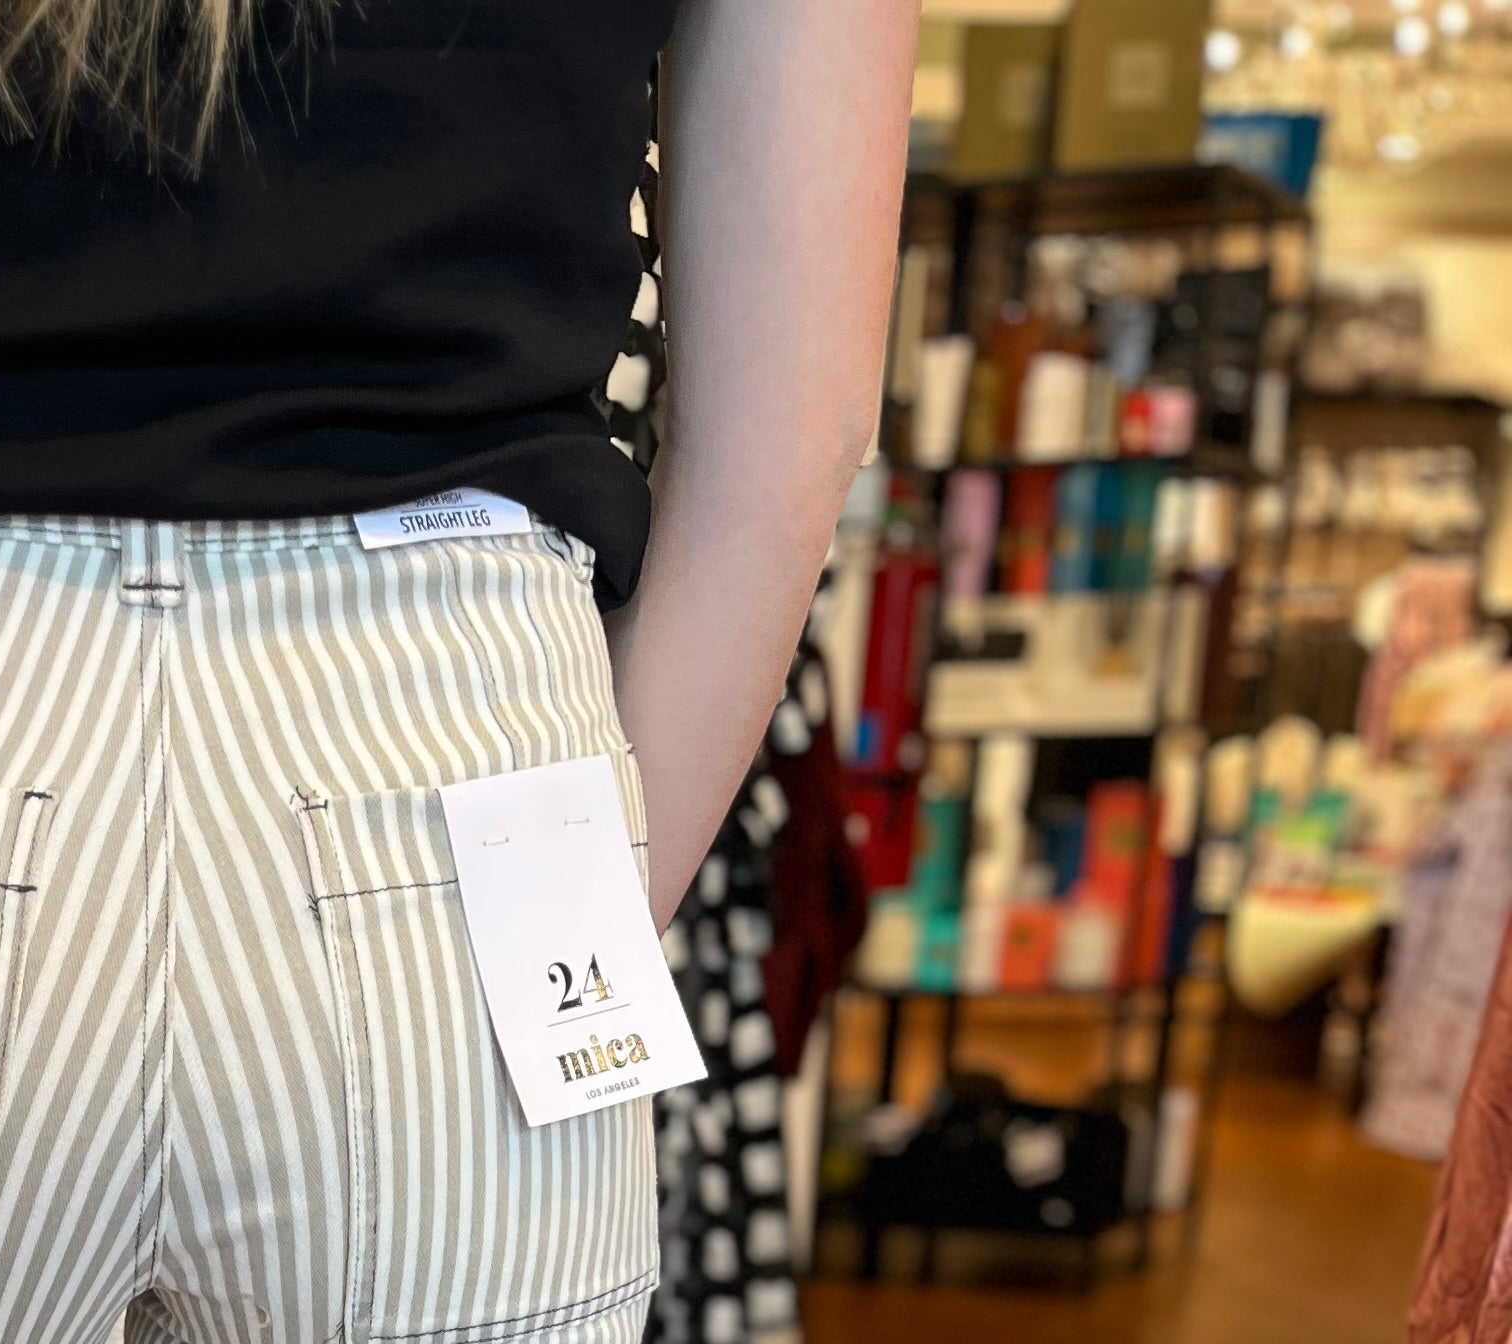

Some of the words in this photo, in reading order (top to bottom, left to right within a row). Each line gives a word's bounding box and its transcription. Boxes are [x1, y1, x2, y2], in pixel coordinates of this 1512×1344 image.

[399, 511, 465, 533] STRAIGHT
[465, 508, 491, 527] LEG
[547, 952, 615, 1013] 24
[556, 1033, 651, 1083] mica
[585, 1088, 603, 1100] LOS
[604, 1076, 641, 1096] ANGELES
